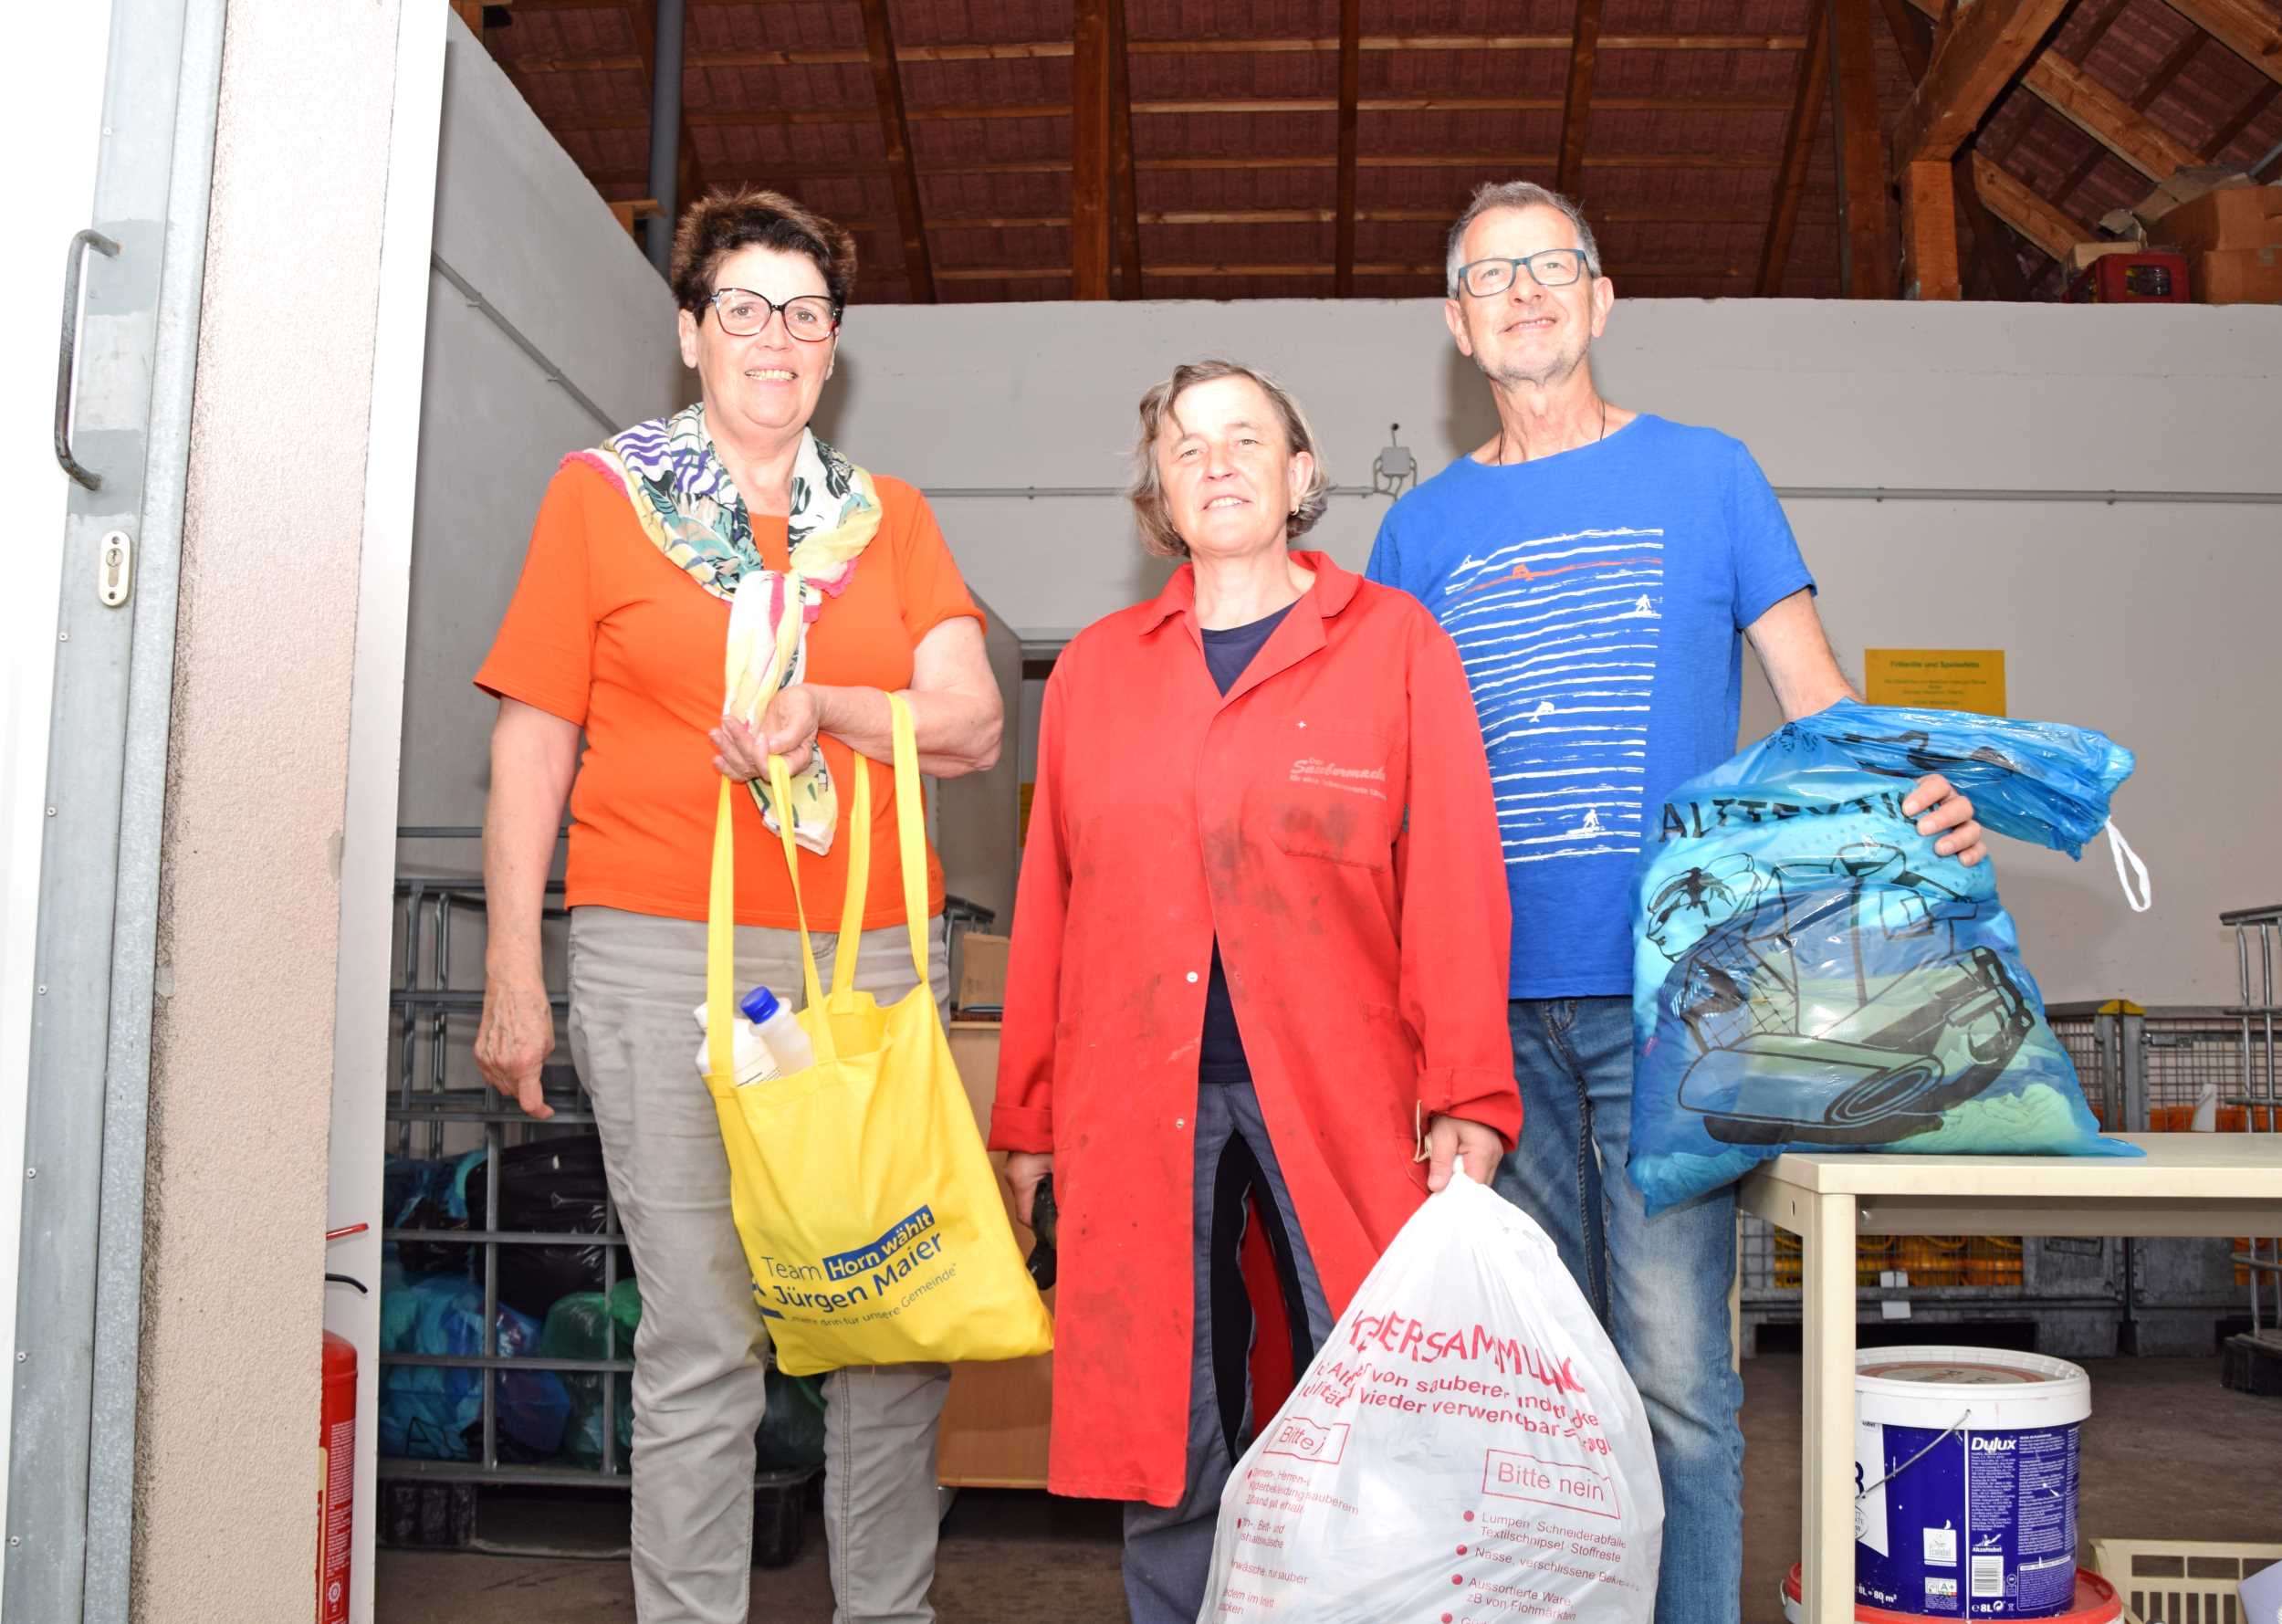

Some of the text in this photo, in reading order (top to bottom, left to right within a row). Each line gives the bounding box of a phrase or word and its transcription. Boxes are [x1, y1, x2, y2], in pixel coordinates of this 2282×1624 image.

[761, 1211, 933, 1282] Team Horn wählt
[773, 1231, 942, 1313] Jürgen Maier
[862, 1305, 902, 1323] unsere
[1373, 1370, 1408, 1388] von
[1280, 1425, 1314, 1451] Bitte
[1972, 1437, 2016, 1452] Dulux
[1498, 1462, 1605, 1502] Bitte nein
[1570, 1543, 1621, 1562] Stoffreste
[1520, 1556, 1596, 1580] verschlissene
[1468, 1577, 1538, 1600] Aussortierte
[1486, 1598, 1507, 1609] von
[1980, 1604, 1993, 1612] 8L
